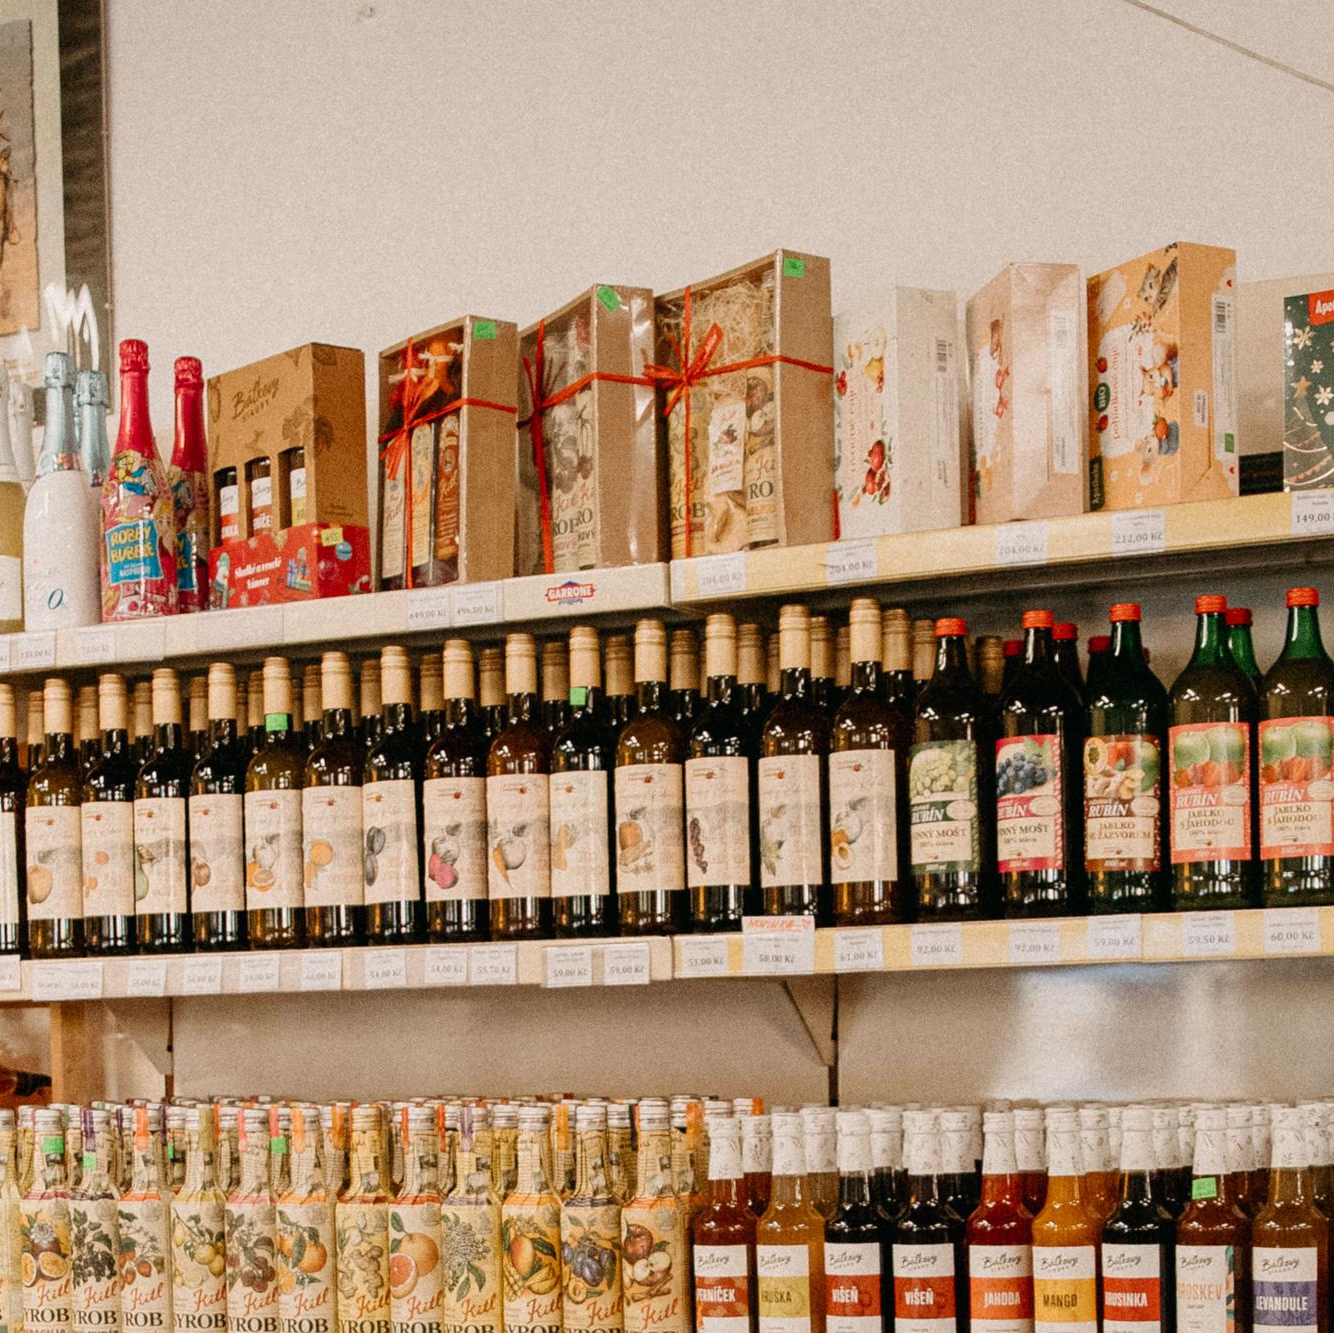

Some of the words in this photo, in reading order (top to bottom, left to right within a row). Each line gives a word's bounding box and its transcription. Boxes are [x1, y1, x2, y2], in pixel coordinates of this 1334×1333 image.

[1296, 512, 1330, 524] 149,00
[110, 526, 152, 546] ROBBY
[1177, 791, 1218, 806] RUBÍN
[1264, 787, 1303, 804] RUBÍN
[1089, 802, 1128, 817] RUBÍN
[1274, 804, 1312, 815] JABLKO
[1301, 930, 1314, 940] Kč
[832, 1286, 858, 1303] VIŠEŇ
[905, 1287, 934, 1306] VIŠEŇ
[984, 1290, 1020, 1307] JAHODA
[1043, 1292, 1078, 1308] MANGO
[228, 1314, 277, 1333] YROB
[281, 1315, 328, 1333] YROB
